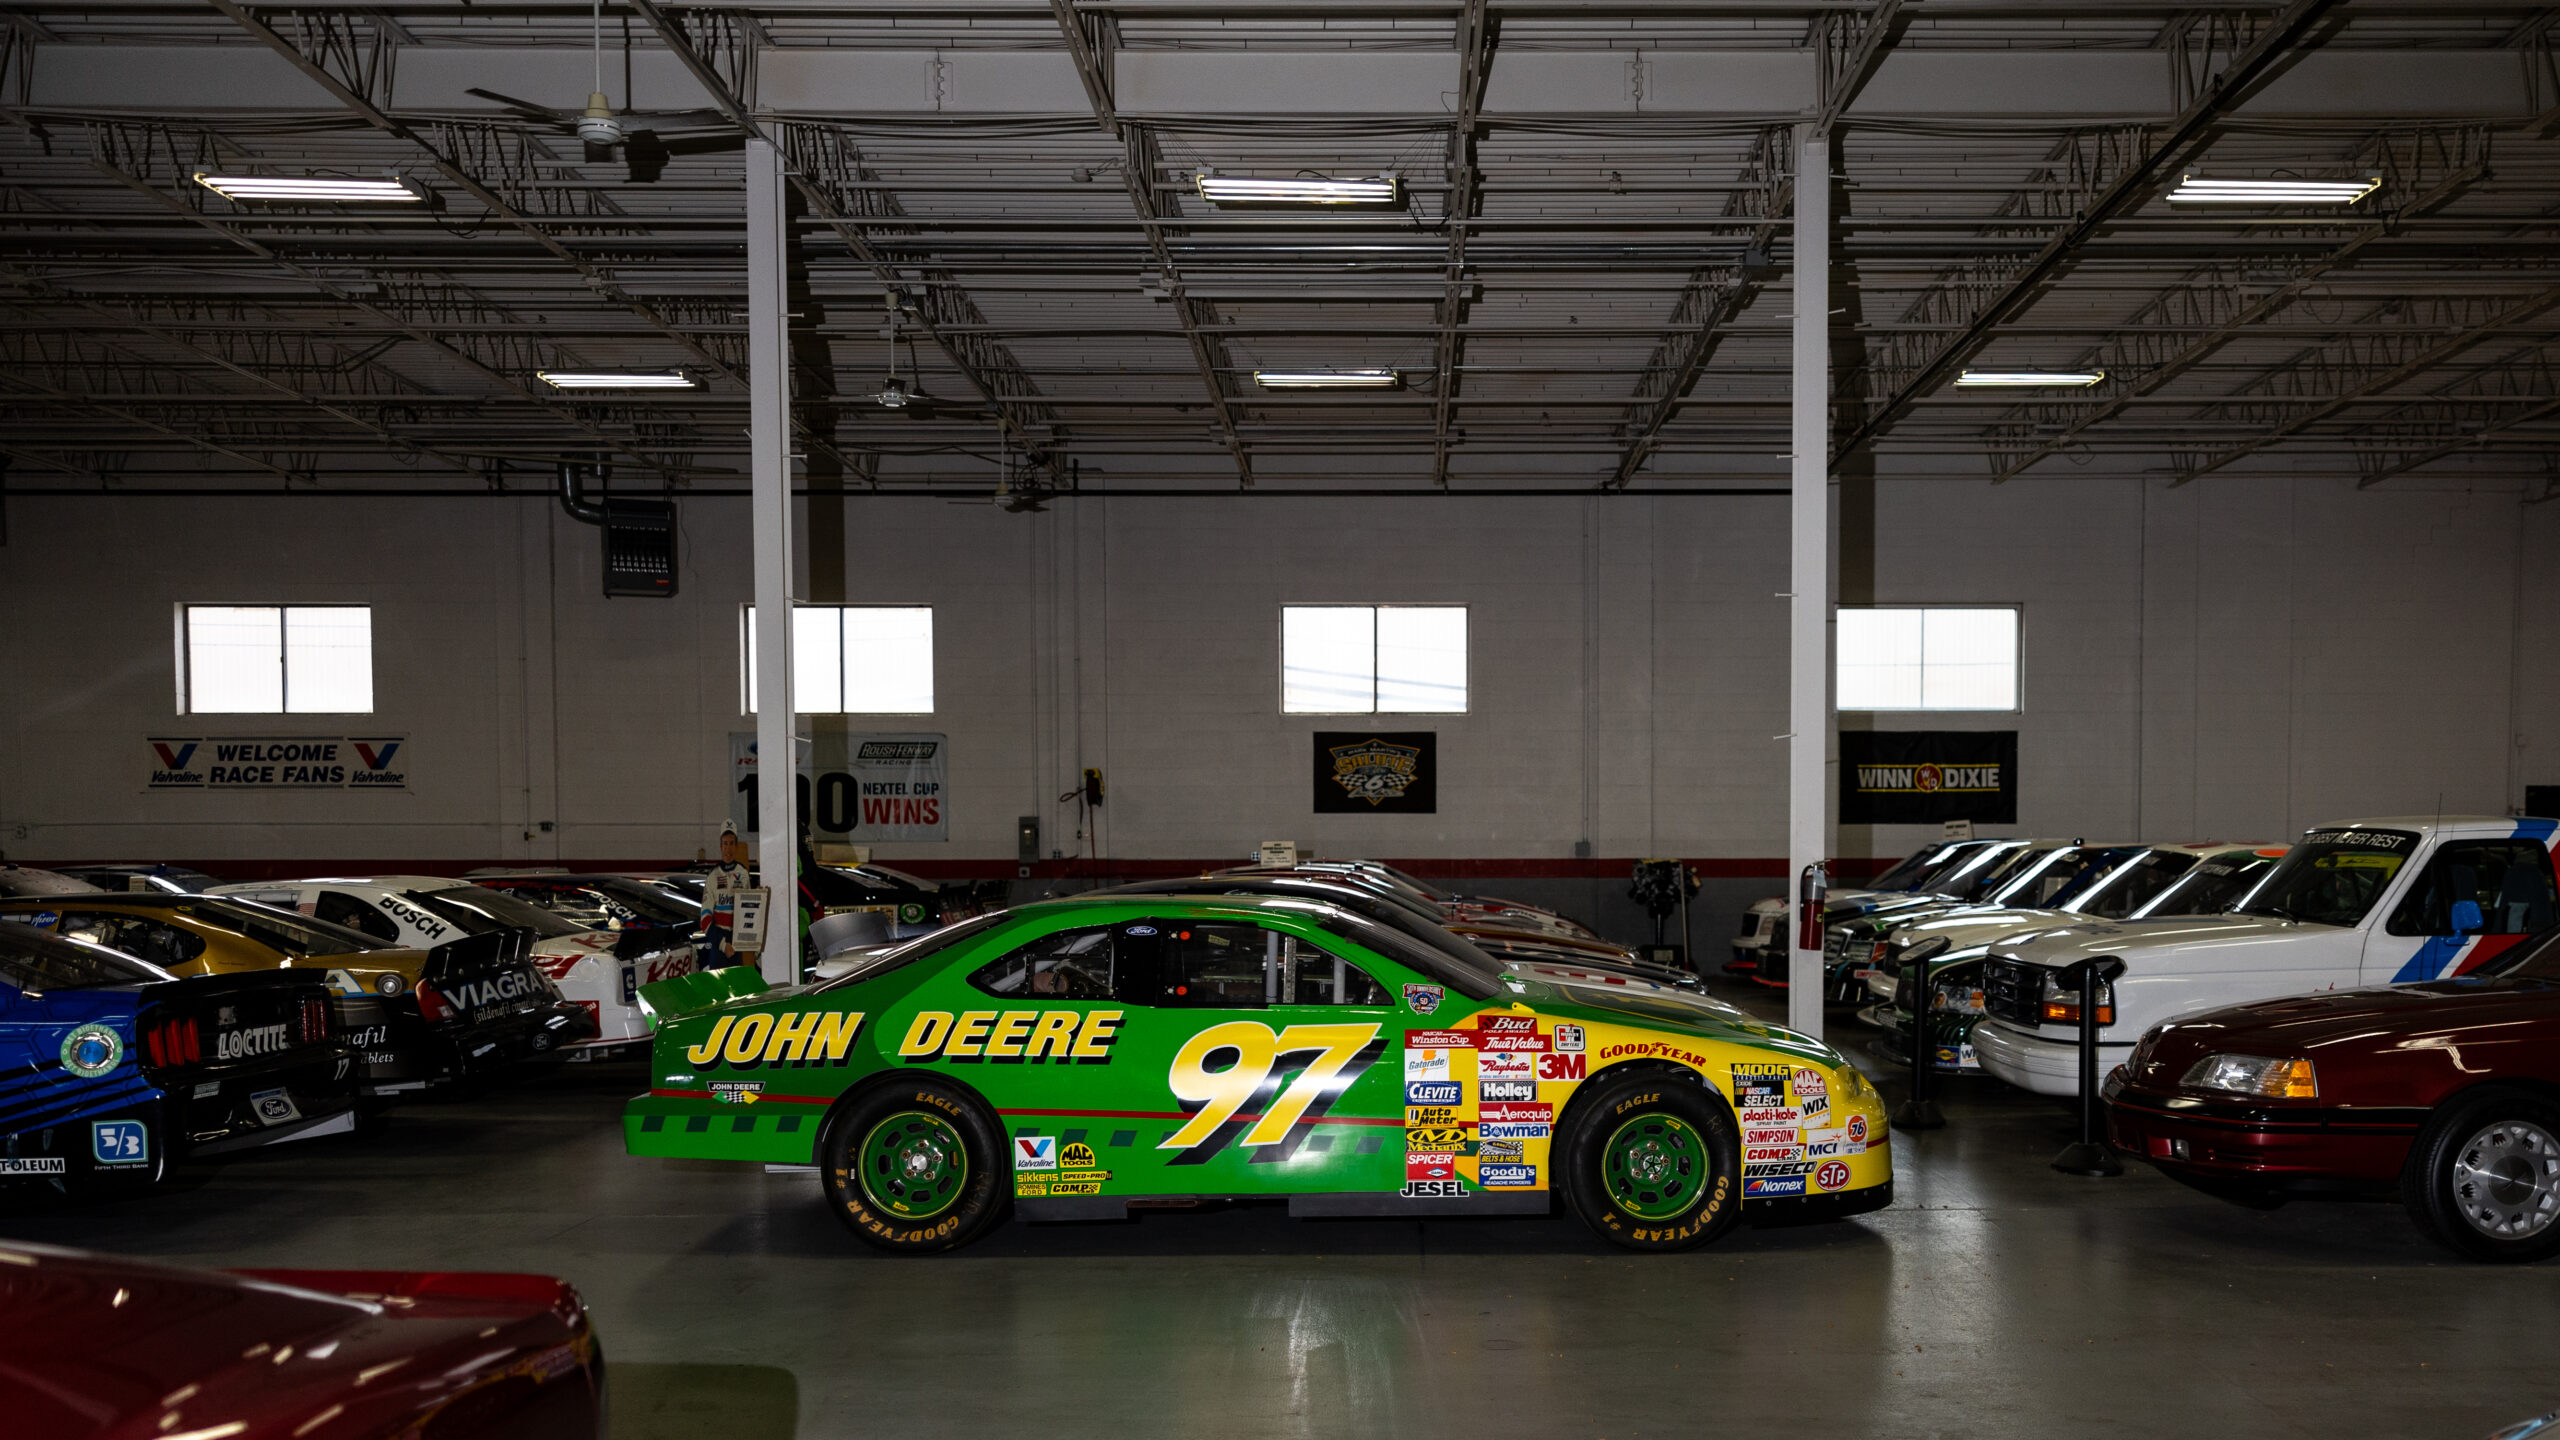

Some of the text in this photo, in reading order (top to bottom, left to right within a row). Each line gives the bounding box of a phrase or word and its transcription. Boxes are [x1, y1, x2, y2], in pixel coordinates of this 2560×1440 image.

[218, 744, 337, 762] WELCOME
[151, 770, 203, 783] Valvoline
[210, 766, 344, 783] RACE FANS
[351, 770, 404, 783] Valvoline
[1857, 767, 2000, 788] WINN DIXIE
[863, 782, 939, 795] NEXTEL CUP
[1364, 774, 1384, 791] 6
[738, 773, 858, 833] 10
[863, 798, 939, 825] WINS
[2370, 834, 2406, 849] REST
[379, 895, 447, 940] BOSCH
[1130, 927, 1154, 935] Ford
[442, 970, 544, 1011] VIAGRA
[1491, 1017, 1536, 1030] Bud
[217, 1024, 288, 1060] LOCTITE
[687, 1009, 1126, 1066] JOHN DEERE
[1411, 1035, 1470, 1045] Winston Cup
[1408, 1058, 1445, 1071] Gatorade
[1479, 1060, 1530, 1075] Raybestos
[1538, 1053, 1586, 1079] 3M
[1733, 1064, 1789, 1076] MOOG
[1794, 1070, 1824, 1088] MAC
[1156, 1020, 1386, 1155] 97
[1408, 1082, 1458, 1099] CLEVITE
[1483, 1082, 1533, 1100] Holley
[1746, 1087, 1771, 1095] NASCAR
[1794, 1086, 1826, 1094] TOOLS
[264, 1100, 287, 1116] Ford
[914, 1091, 962, 1117] EAGLE
[1615, 1092, 1662, 1115] EAGLE
[1744, 1095, 1784, 1107] SELECT
[1803, 1096, 1829, 1115] WIX
[1421, 1108, 1451, 1117] Auto
[1499, 1103, 1552, 1122] Aeroquip
[1743, 1107, 1798, 1122] plasti-kote
[1419, 1116, 1457, 1126] Meter
[1850, 1121, 1864, 1136] 76
[1479, 1123, 1549, 1137] Bowman
[1747, 1130, 1795, 1144] SIMPSON
[1061, 1145, 1093, 1160] MAC
[1747, 1148, 1791, 1160] COMP
[1808, 1142, 1838, 1156] MCI
[1017, 1159, 1055, 1168] Valvoline
[1407, 1154, 1453, 1165] SPICER
[1481, 1155, 1498, 1163] BELTS
[1505, 1155, 1521, 1163] HOSE
[1016, 1171, 1059, 1182] sikkens
[1063, 1172, 1106, 1180] SPEED-PRO
[1480, 1166, 1536, 1178] Goody's
[1744, 1161, 1818, 1177] WISECO
[1820, 1164, 1846, 1186] STP
[1052, 1184, 1089, 1193] COMP
[1400, 1181, 1469, 1197] JESEL
[1760, 1179, 1804, 1192] Nomex
[1601, 1211, 1624, 1231] #1
